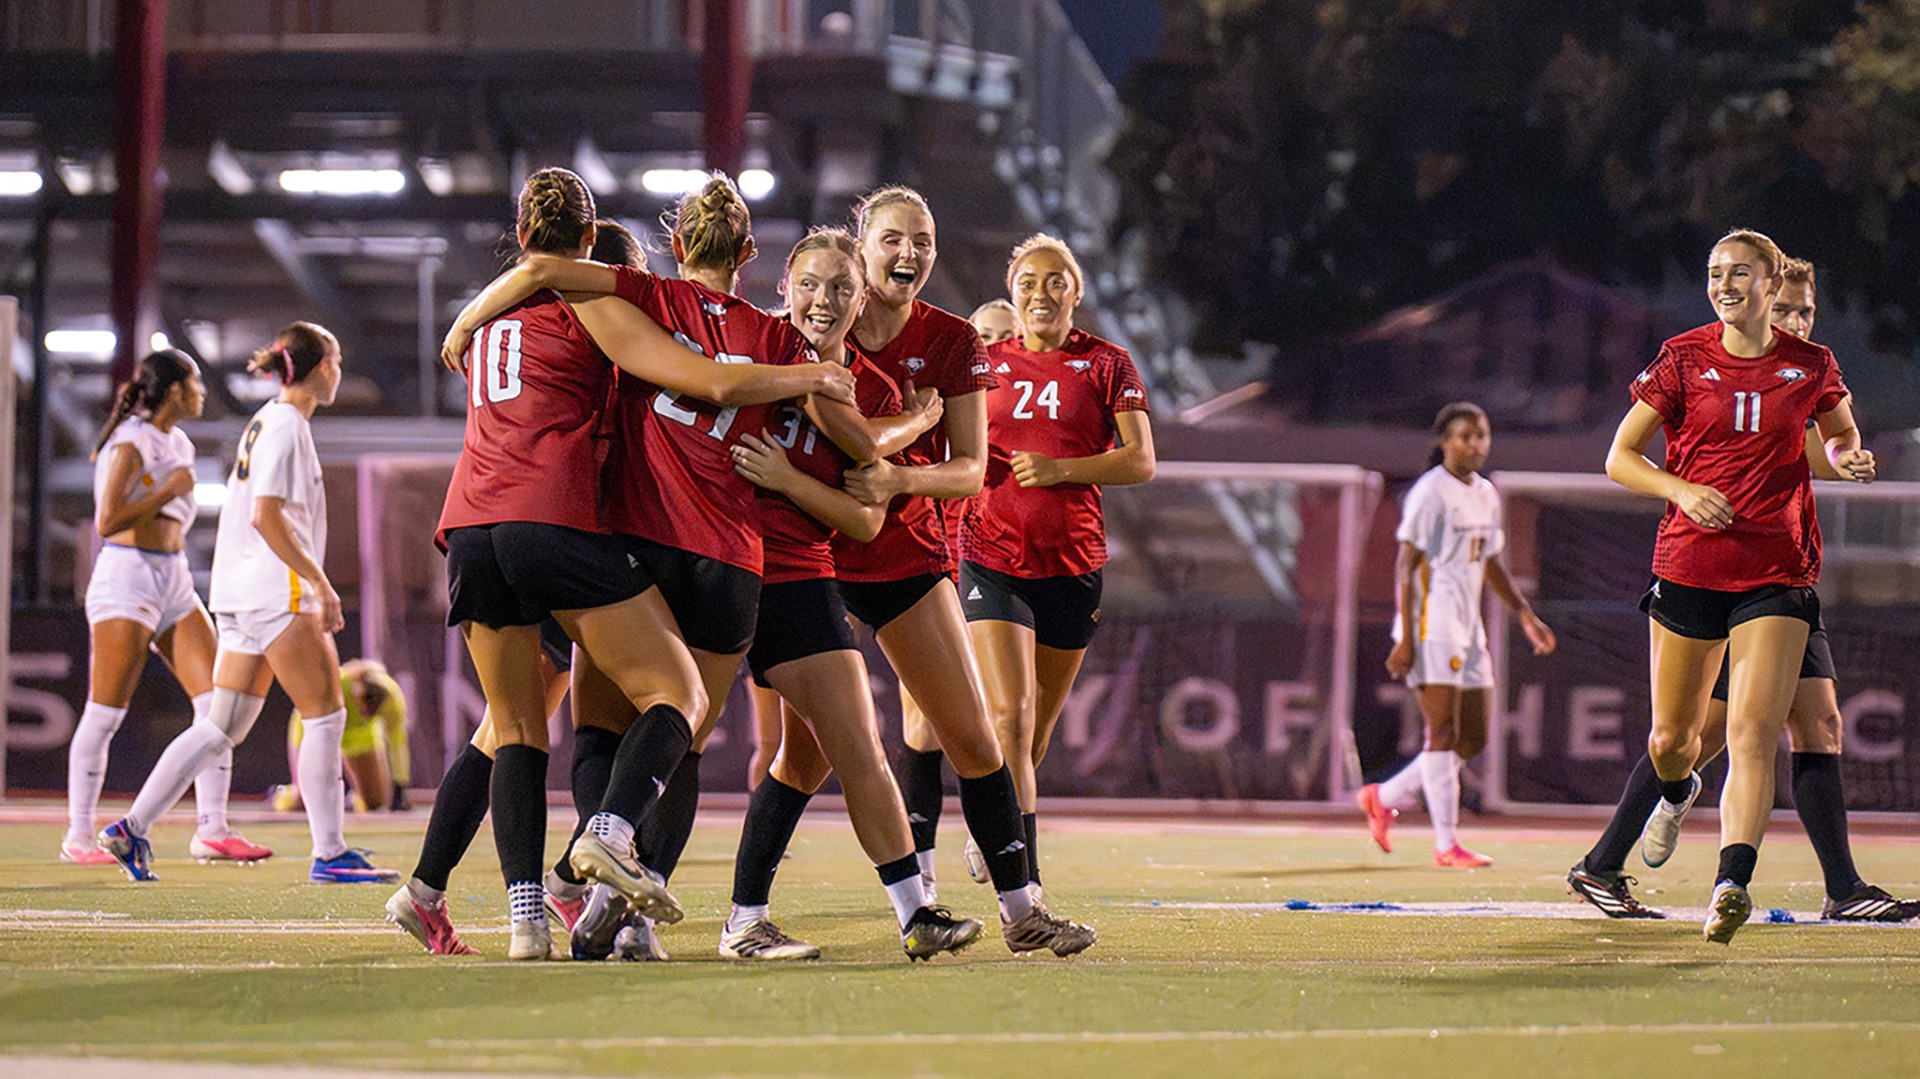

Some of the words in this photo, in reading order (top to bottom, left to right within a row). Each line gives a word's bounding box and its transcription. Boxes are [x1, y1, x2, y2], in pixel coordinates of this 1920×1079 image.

[472, 319, 523, 408] 10
[1012, 380, 1061, 420] 24
[1733, 391, 1761, 433] 11
[236, 420, 263, 481] 9
[772, 405, 820, 456] 31
[1160, 676, 1319, 753] OF
